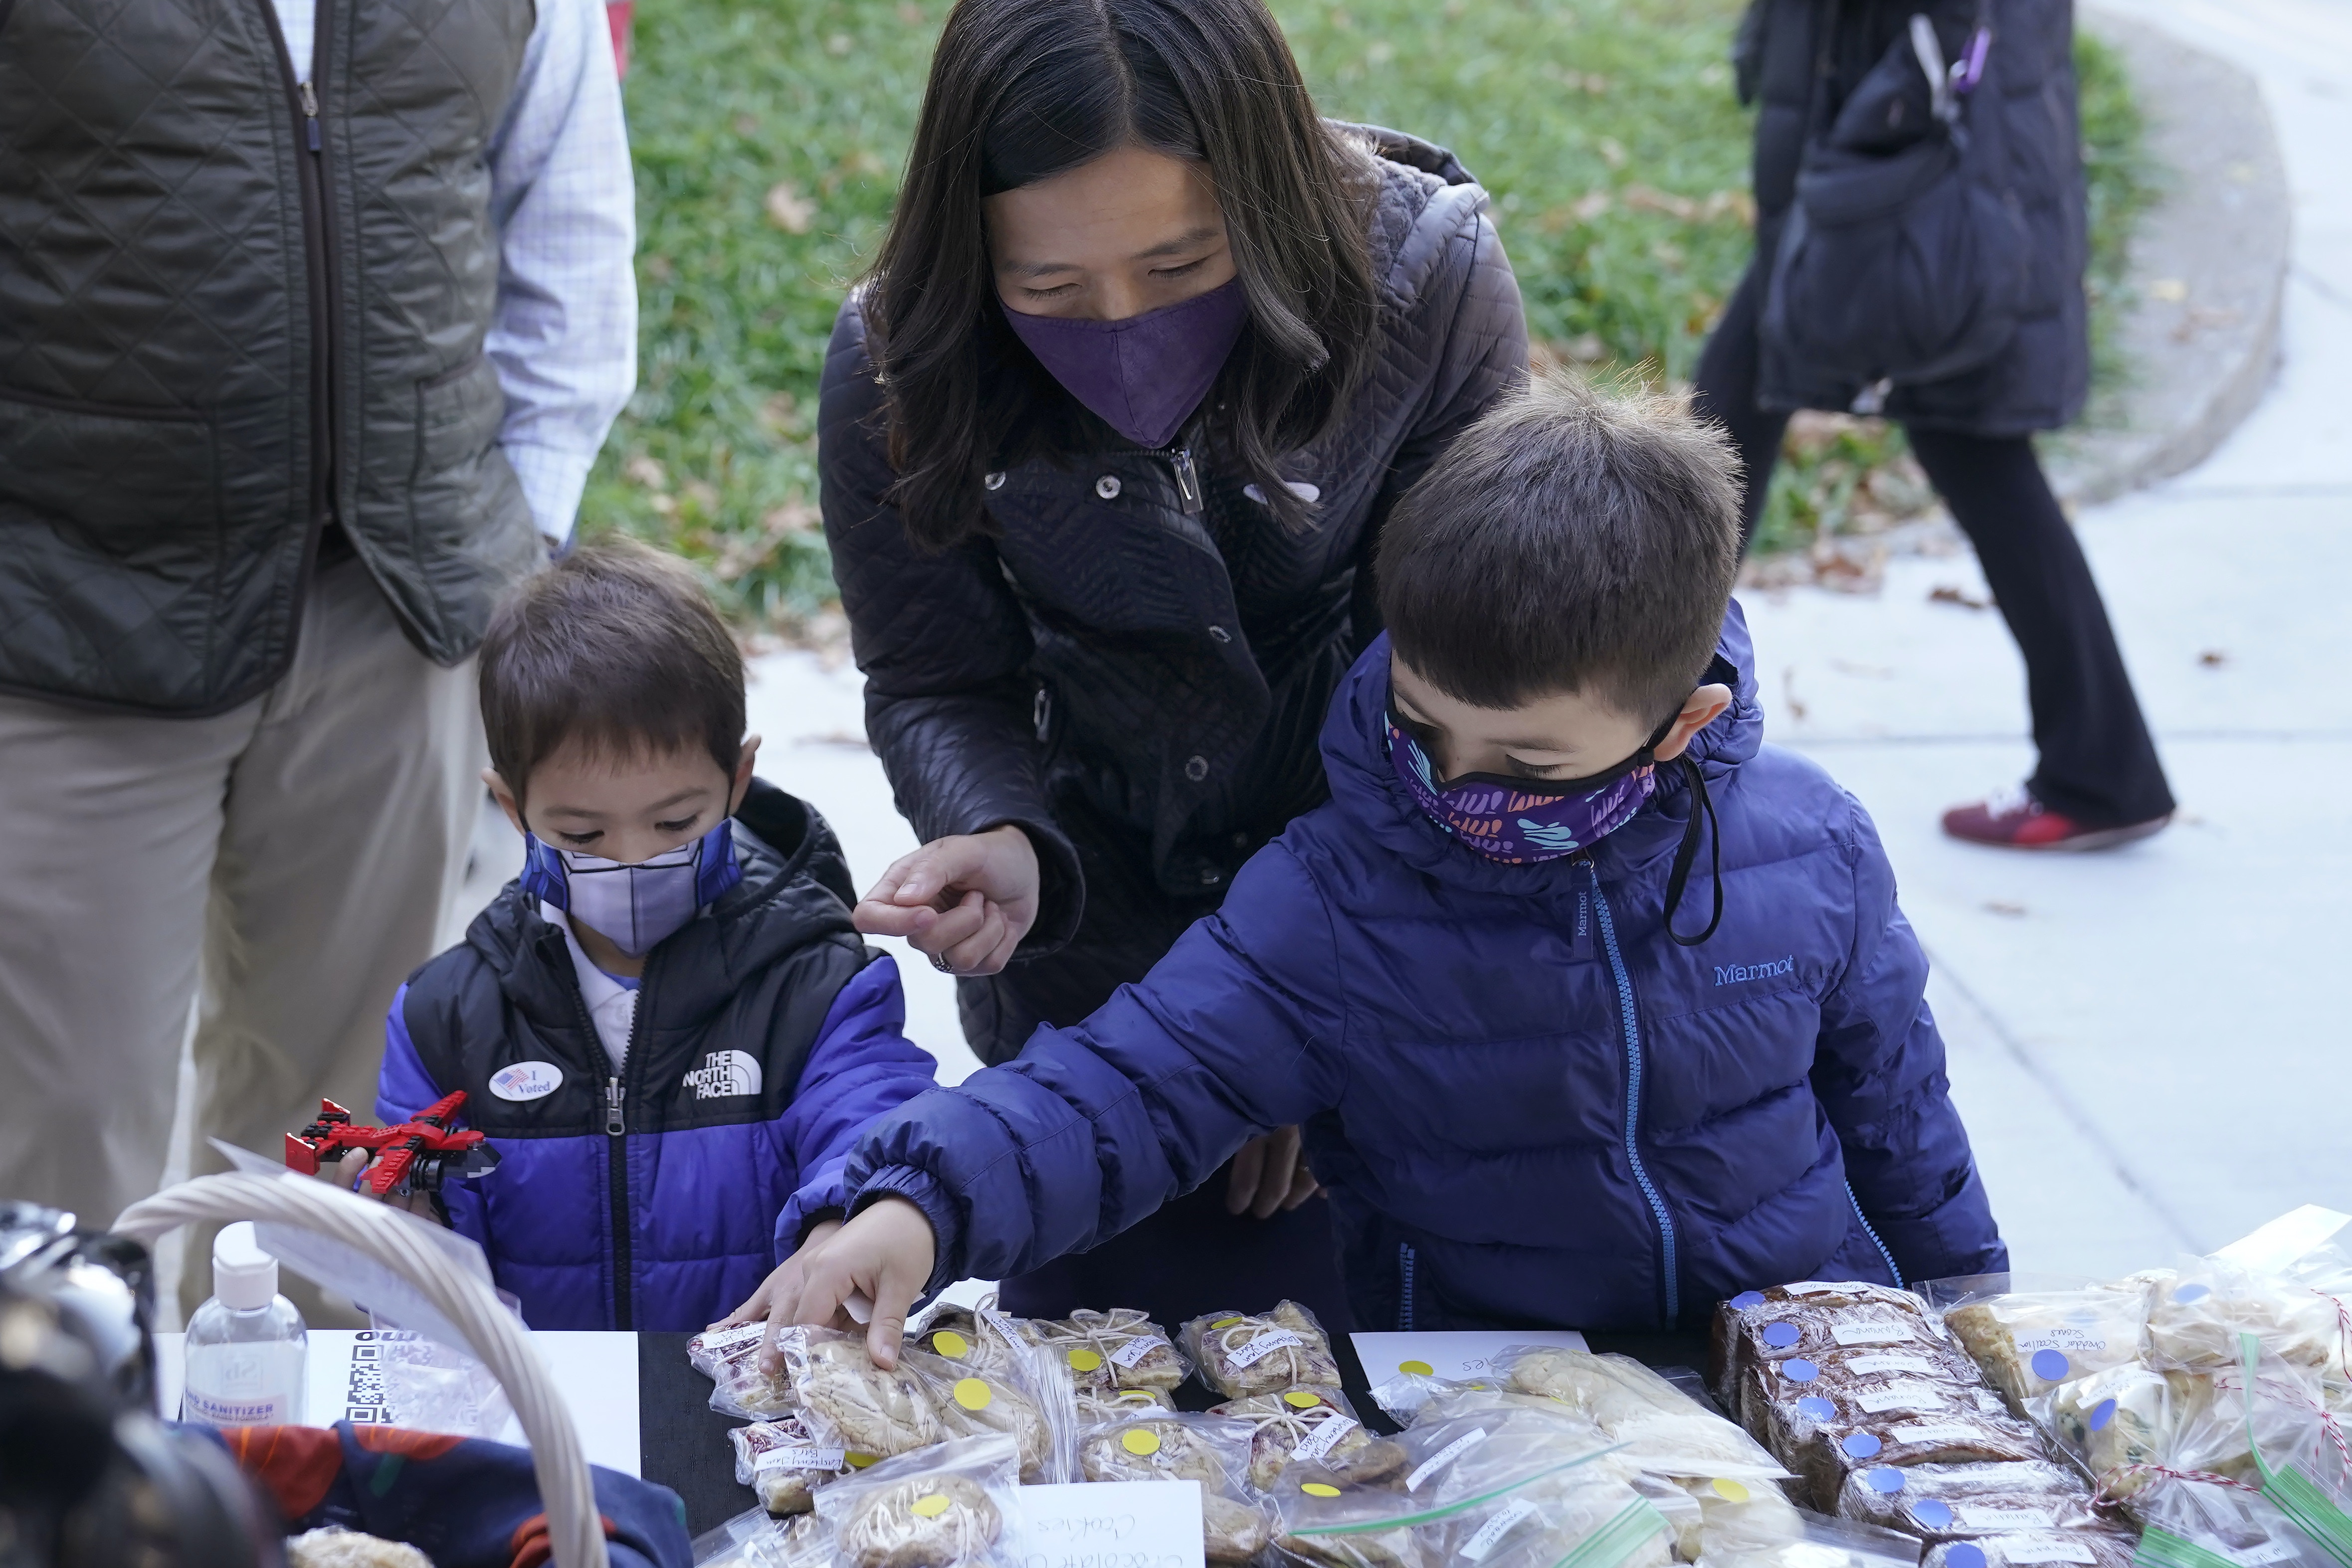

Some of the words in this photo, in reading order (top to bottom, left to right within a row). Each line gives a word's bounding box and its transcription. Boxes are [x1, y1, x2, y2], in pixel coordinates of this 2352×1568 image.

[1577, 891, 1587, 936] Marmot
[1714, 954, 1794, 987] Marmot
[705, 1050, 732, 1068] THE
[531, 1070, 536, 1081] I
[682, 1065, 732, 1087] NORTH
[518, 1082, 550, 1094] Voted
[696, 1080, 732, 1100] FACE
[1842, 1325, 1905, 1336] Banana
[2050, 1329, 2084, 1339] Scones
[2065, 1341, 2106, 1350] Cheddar
[203, 1400, 274, 1415] SANITIZER
[1037, 1514, 1135, 1543] Cookies
